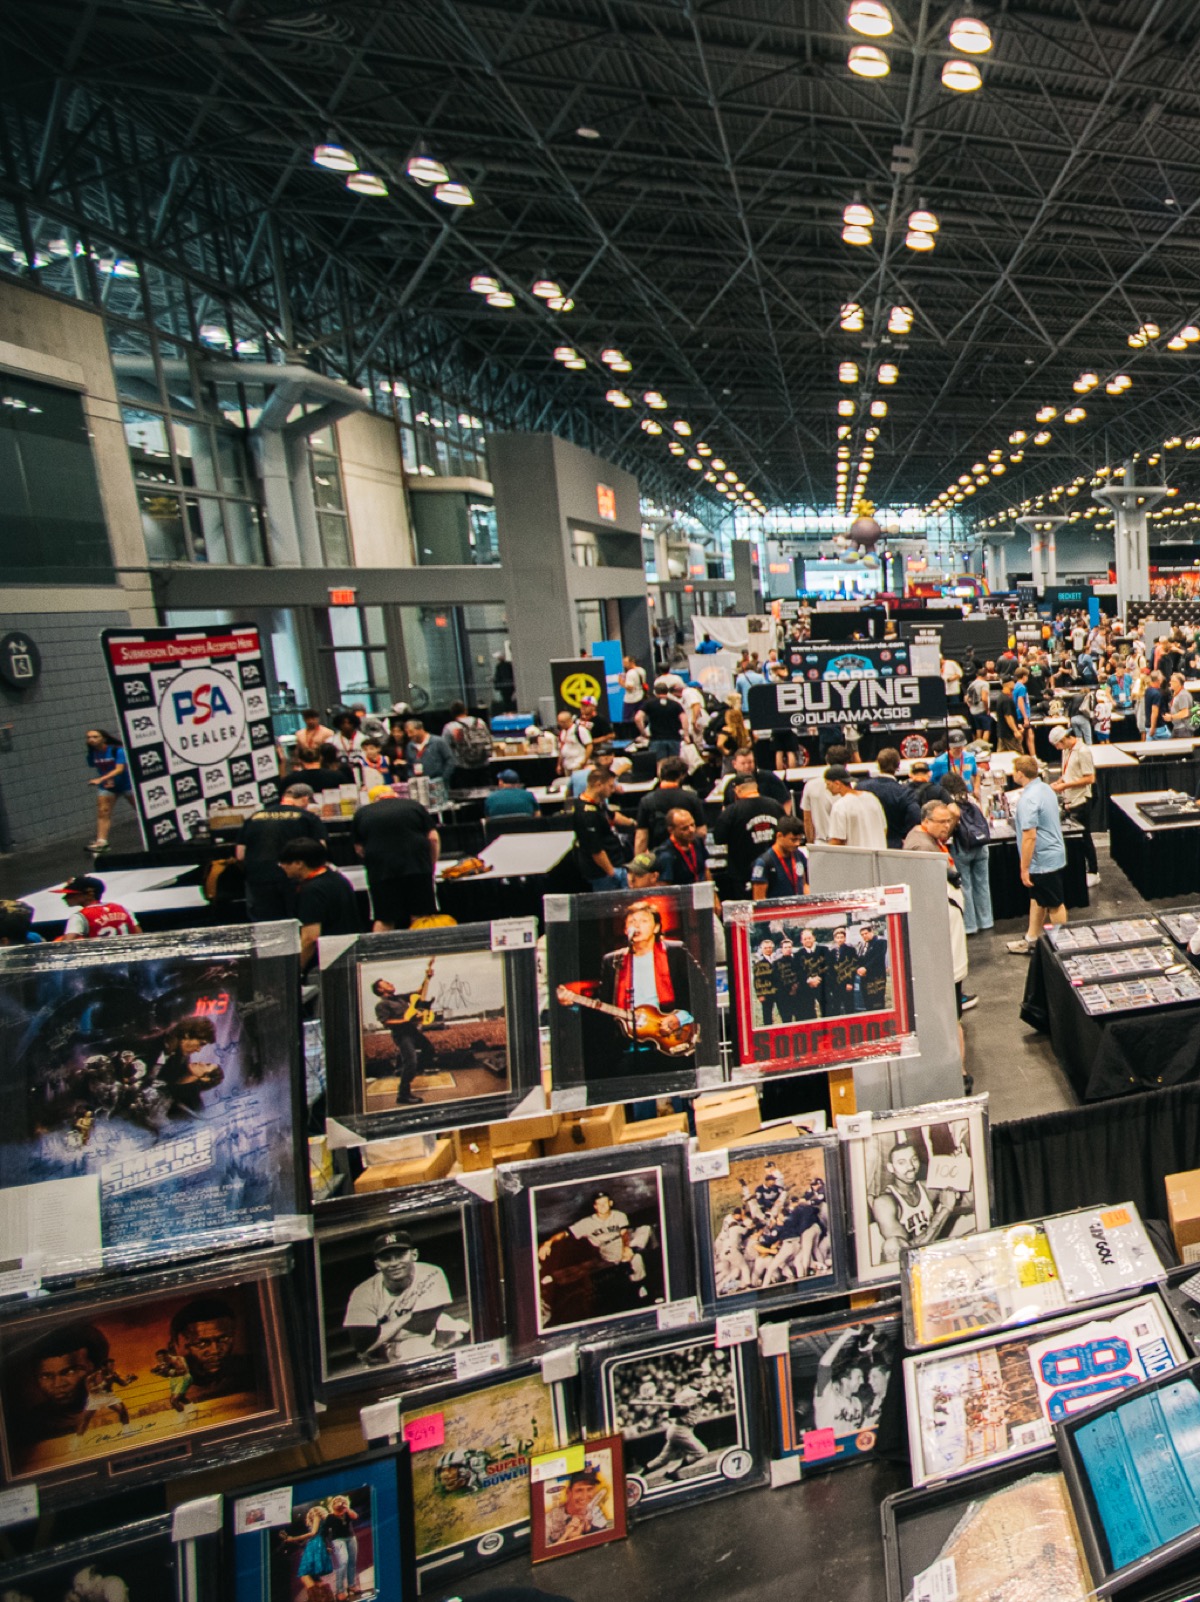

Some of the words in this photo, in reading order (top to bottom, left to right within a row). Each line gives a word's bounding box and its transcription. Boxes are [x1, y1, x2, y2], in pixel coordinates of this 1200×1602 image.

[172, 684, 232, 725] PSA
[776, 677, 920, 713] BUYING
[180, 725, 236, 750] DEALER
[102, 1129, 212, 1184] EMPIRE
[102, 1164, 170, 1195] STRIKES
[171, 1151, 212, 1172] BACK
[1095, 1241, 1116, 1266] GOLF
[486, 1456, 527, 1476] SUPER
[732, 1456, 742, 1472] 7
